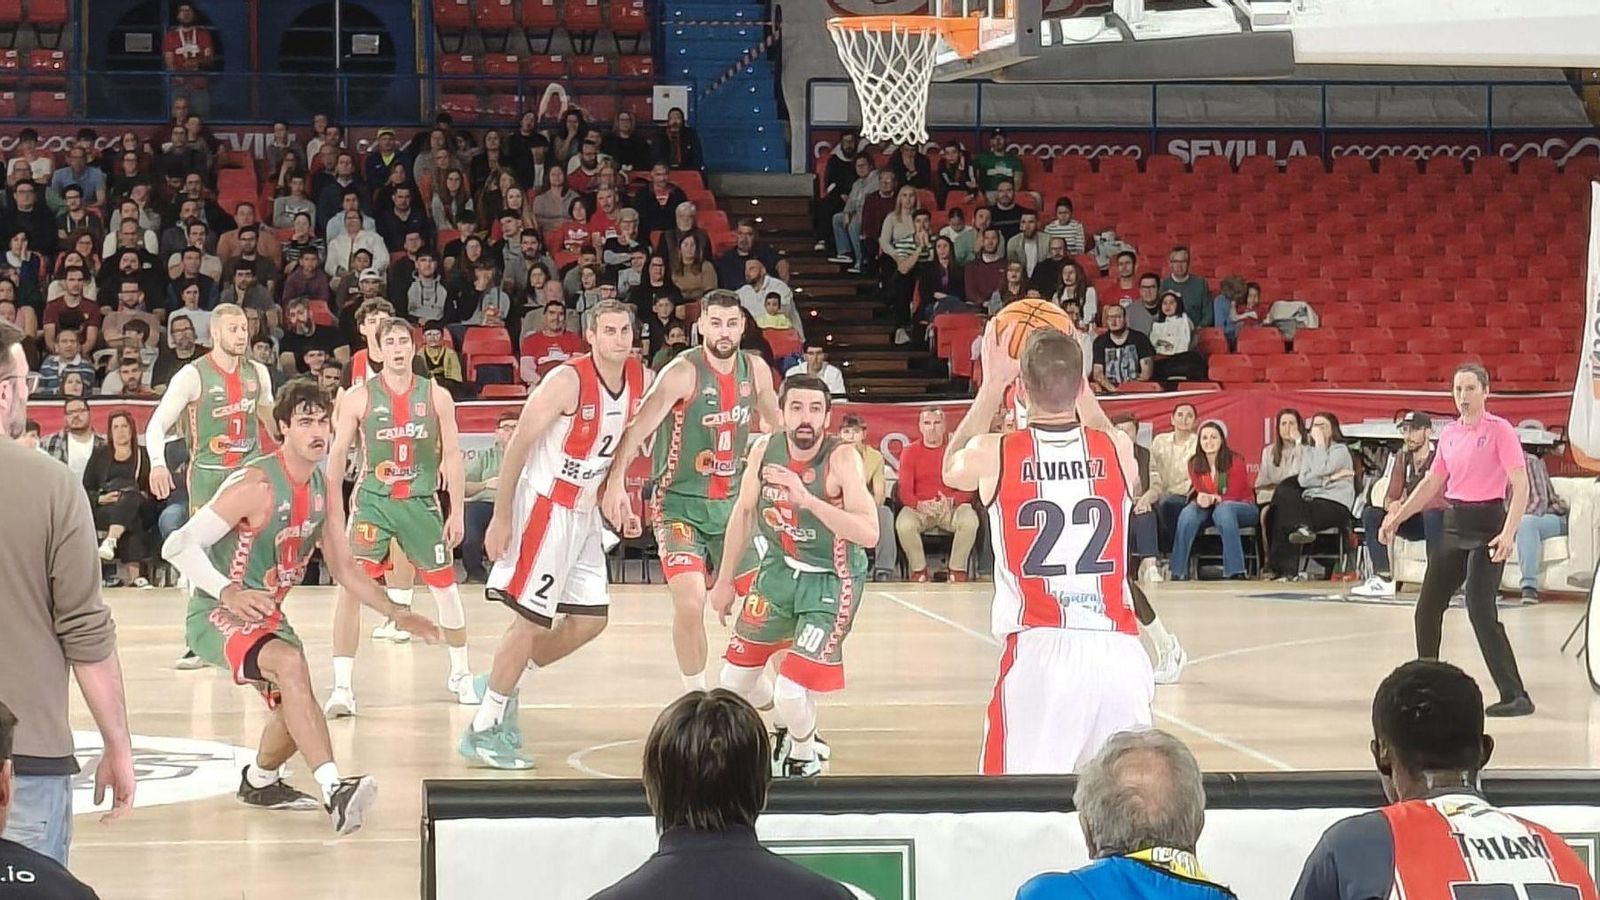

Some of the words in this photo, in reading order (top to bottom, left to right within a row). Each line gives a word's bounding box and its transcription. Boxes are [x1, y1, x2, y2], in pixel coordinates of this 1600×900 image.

[598, 435, 614, 458] 2
[1017, 498, 1115, 577] 22
[534, 573, 555, 600] 2
[1451, 831, 1552, 861] THIAM
